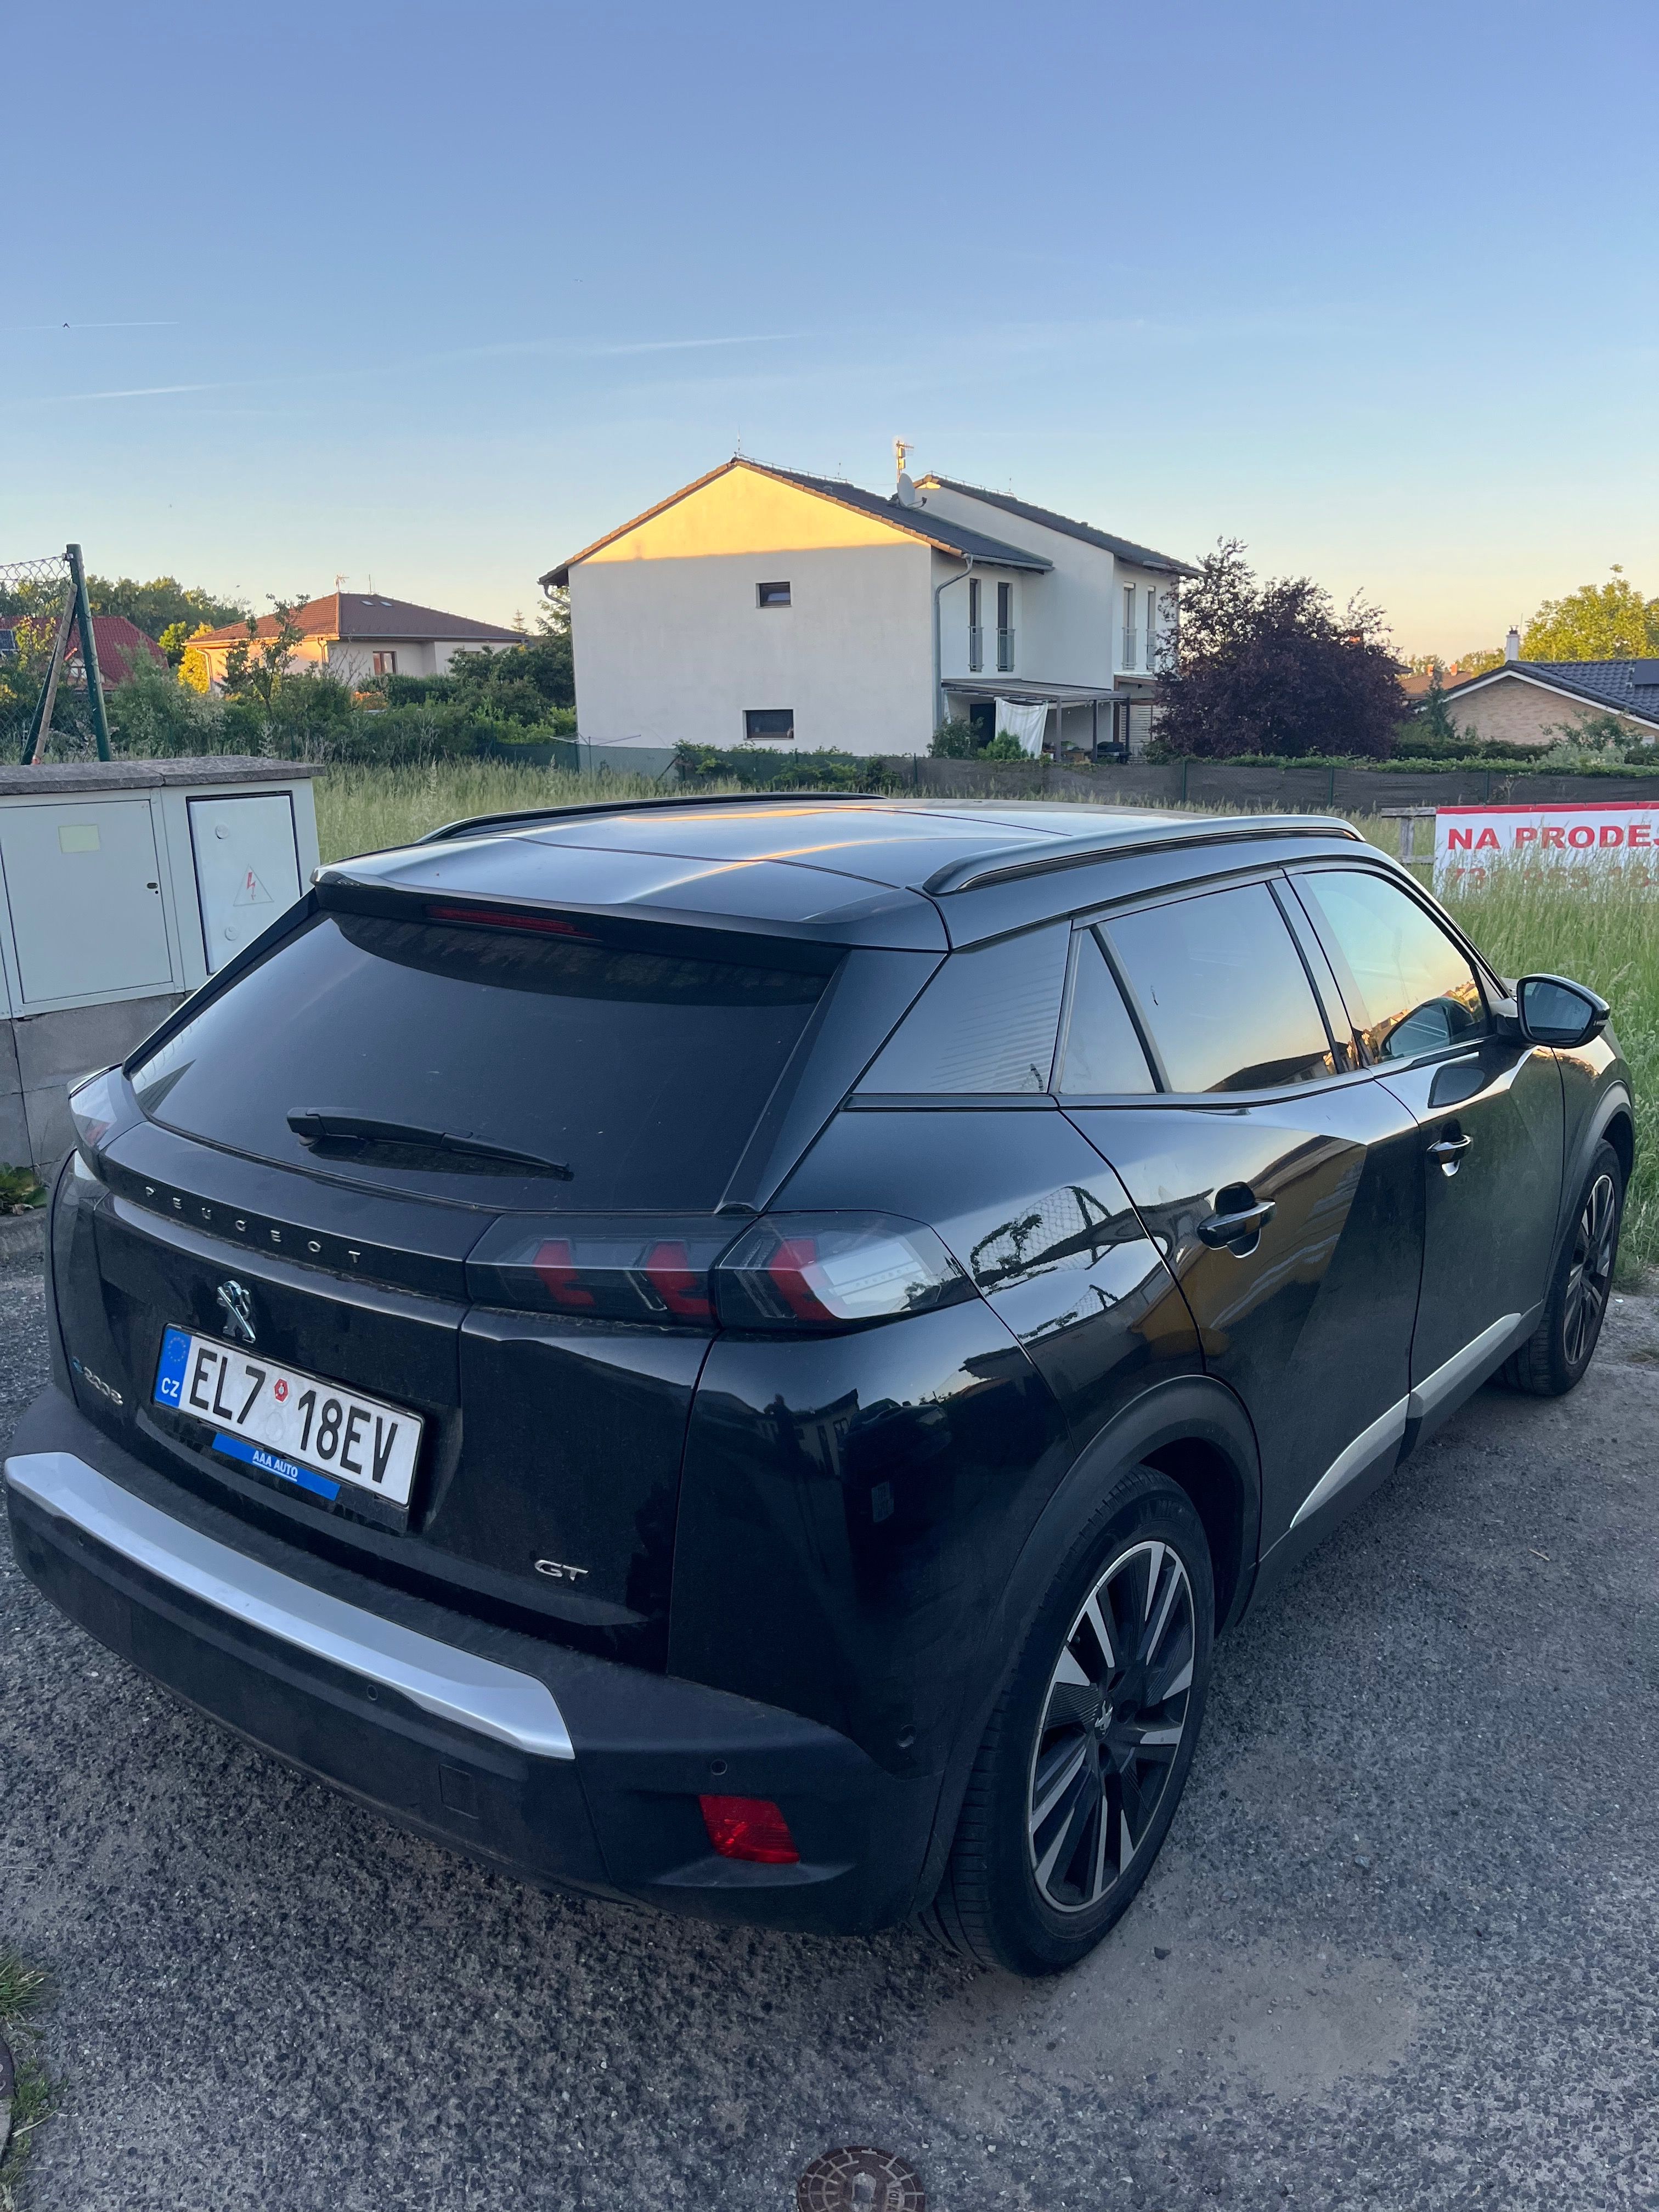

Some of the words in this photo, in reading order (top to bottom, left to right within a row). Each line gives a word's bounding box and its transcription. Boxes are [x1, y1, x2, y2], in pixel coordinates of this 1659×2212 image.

[1448, 828, 1501, 850] NA
[1515, 825, 1659, 849] PRODE
[145, 1186, 361, 1263] PEUGEOT
[161, 1376, 180, 1398] CZ
[189, 1347, 266, 1424] EL7
[298, 1390, 398, 1483] 18EV
[252, 1450, 272, 1467] AAA
[274, 1459, 298, 1478] AUTO
[534, 1559, 589, 1581] GT
